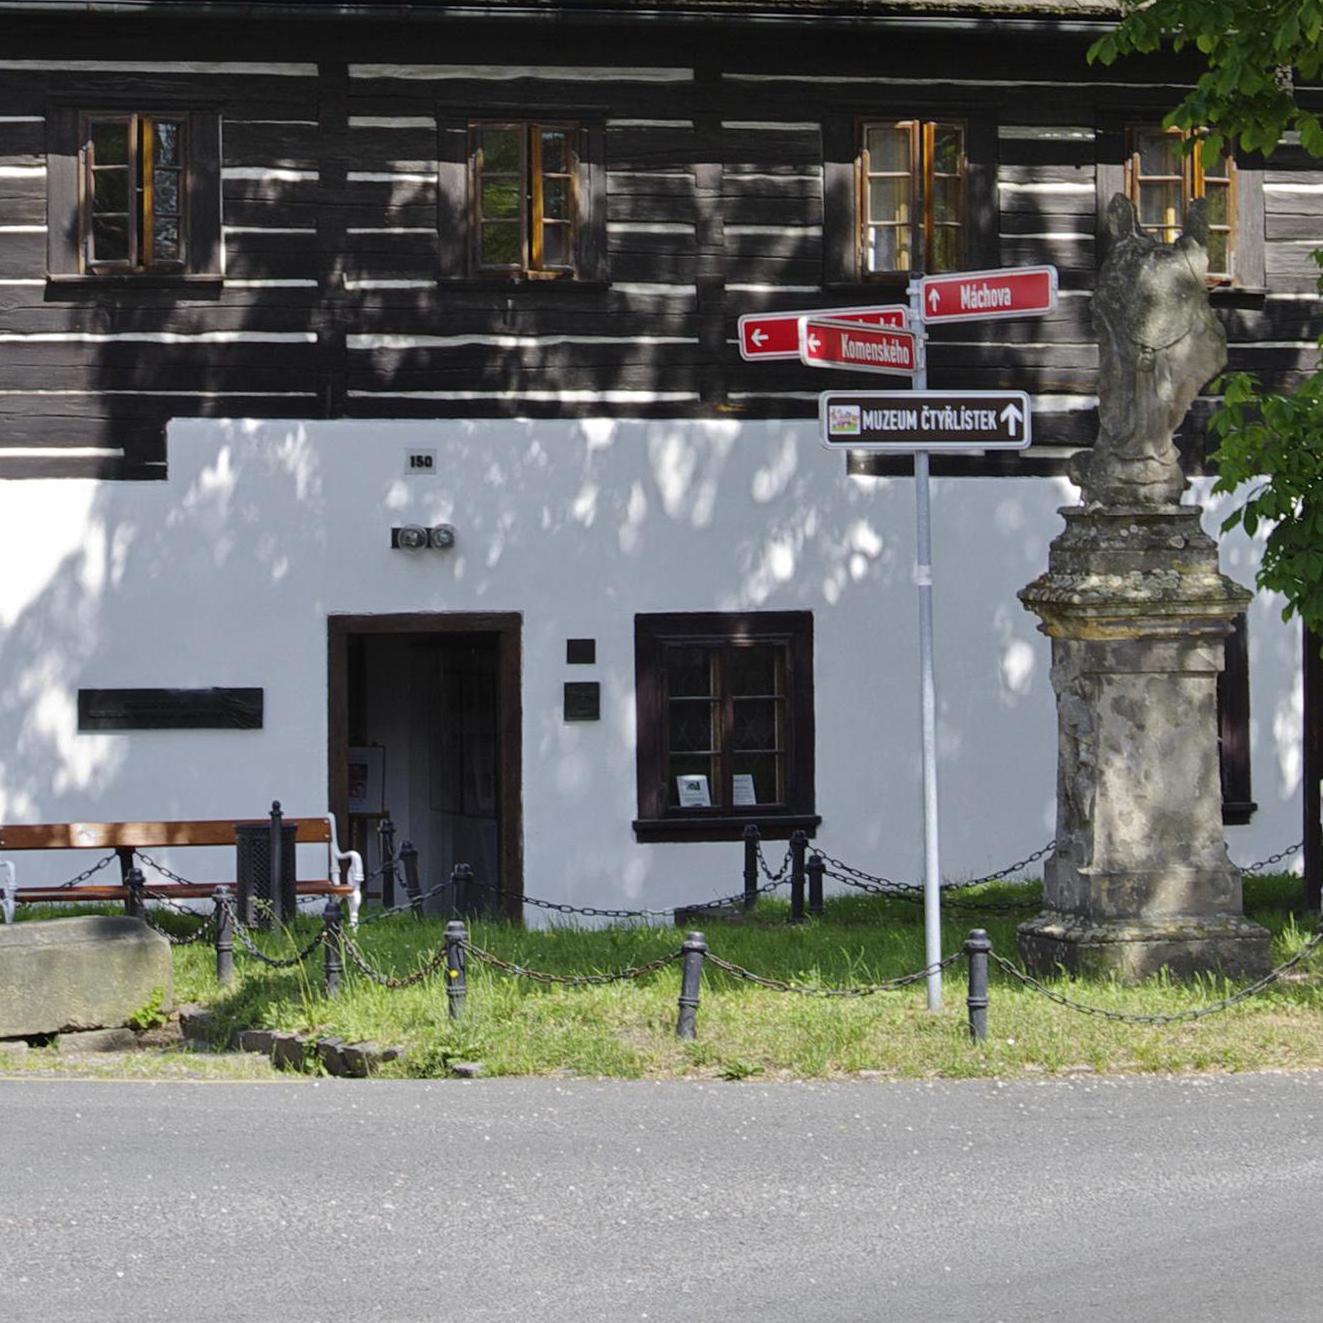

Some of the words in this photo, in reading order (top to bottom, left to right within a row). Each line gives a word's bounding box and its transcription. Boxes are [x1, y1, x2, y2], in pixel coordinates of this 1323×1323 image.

[960, 282, 1012, 310] Máchova
[840, 332, 910, 365] Komenského
[862, 409, 918, 431] MUZEUM
[920, 405, 998, 431] ČTYŘLÍSTEK
[410, 454, 433, 468] 150
